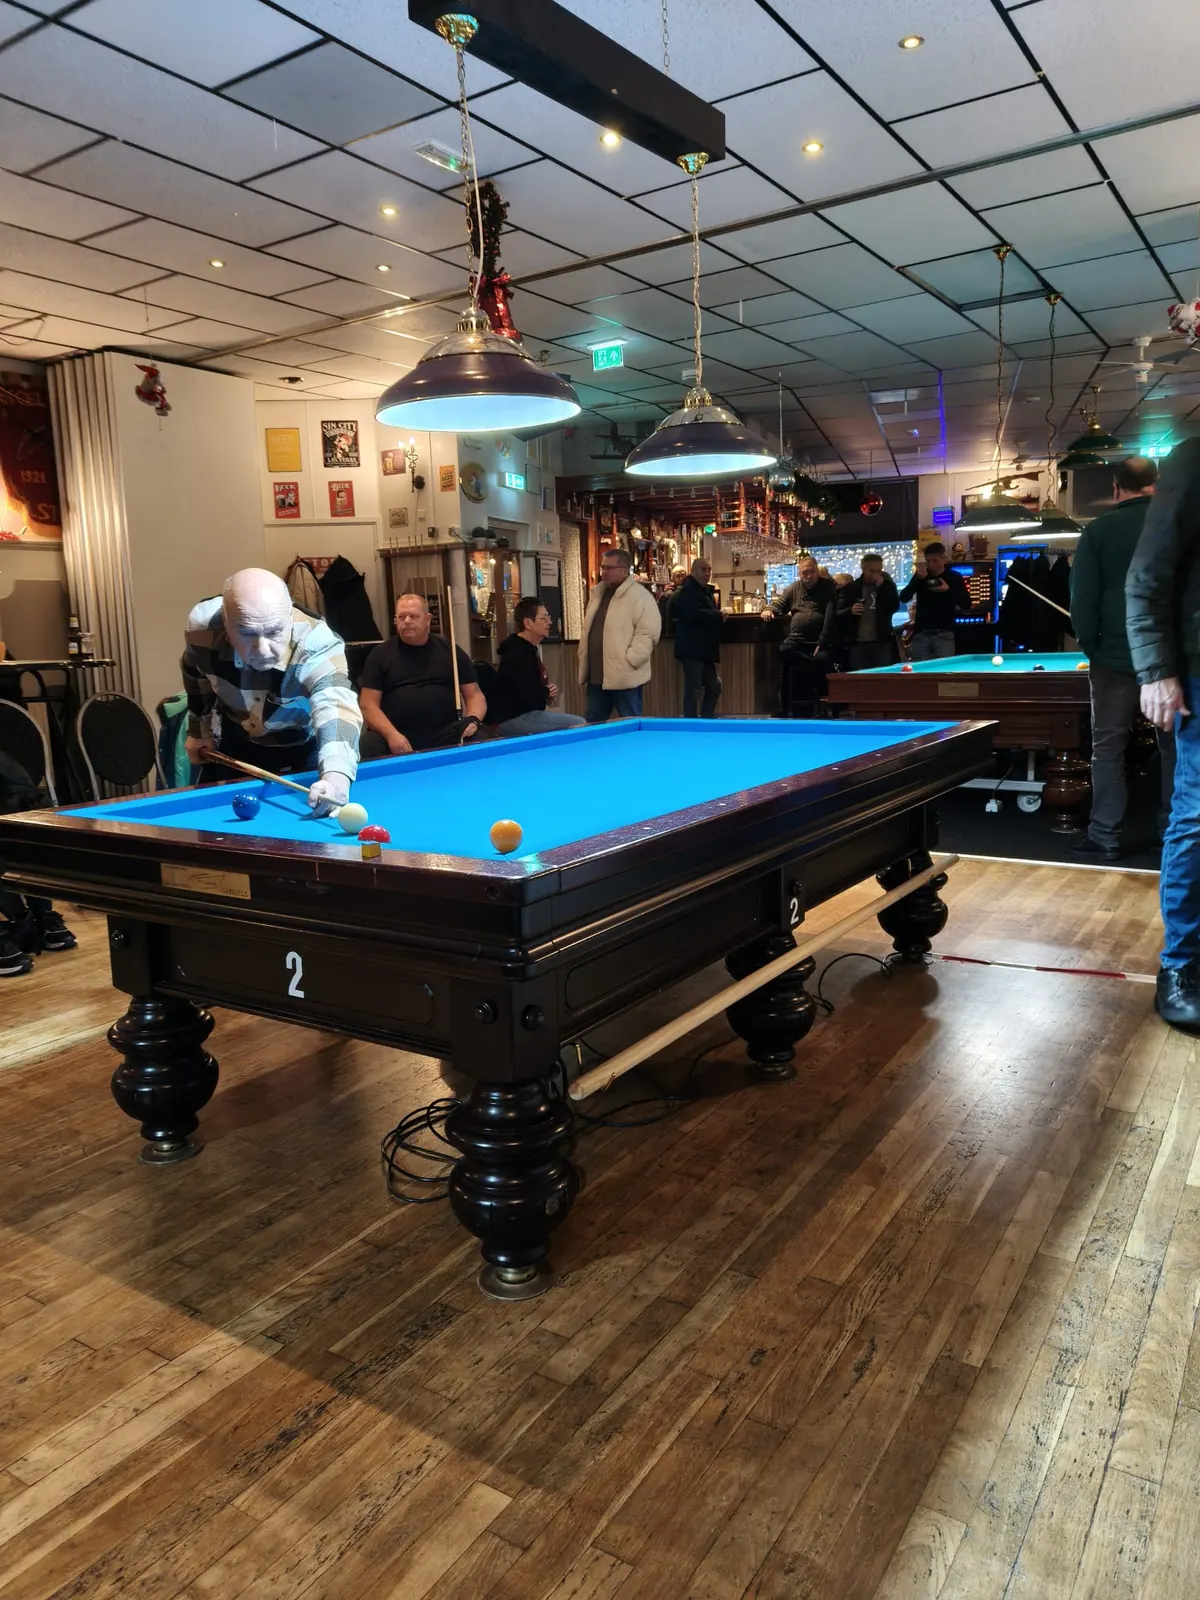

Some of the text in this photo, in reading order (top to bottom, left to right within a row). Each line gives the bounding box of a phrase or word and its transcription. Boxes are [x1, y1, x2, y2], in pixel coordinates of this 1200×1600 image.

[322, 422, 357, 432] SIN CITY
[790, 897, 800, 925] 2
[285, 951, 305, 999] 2
